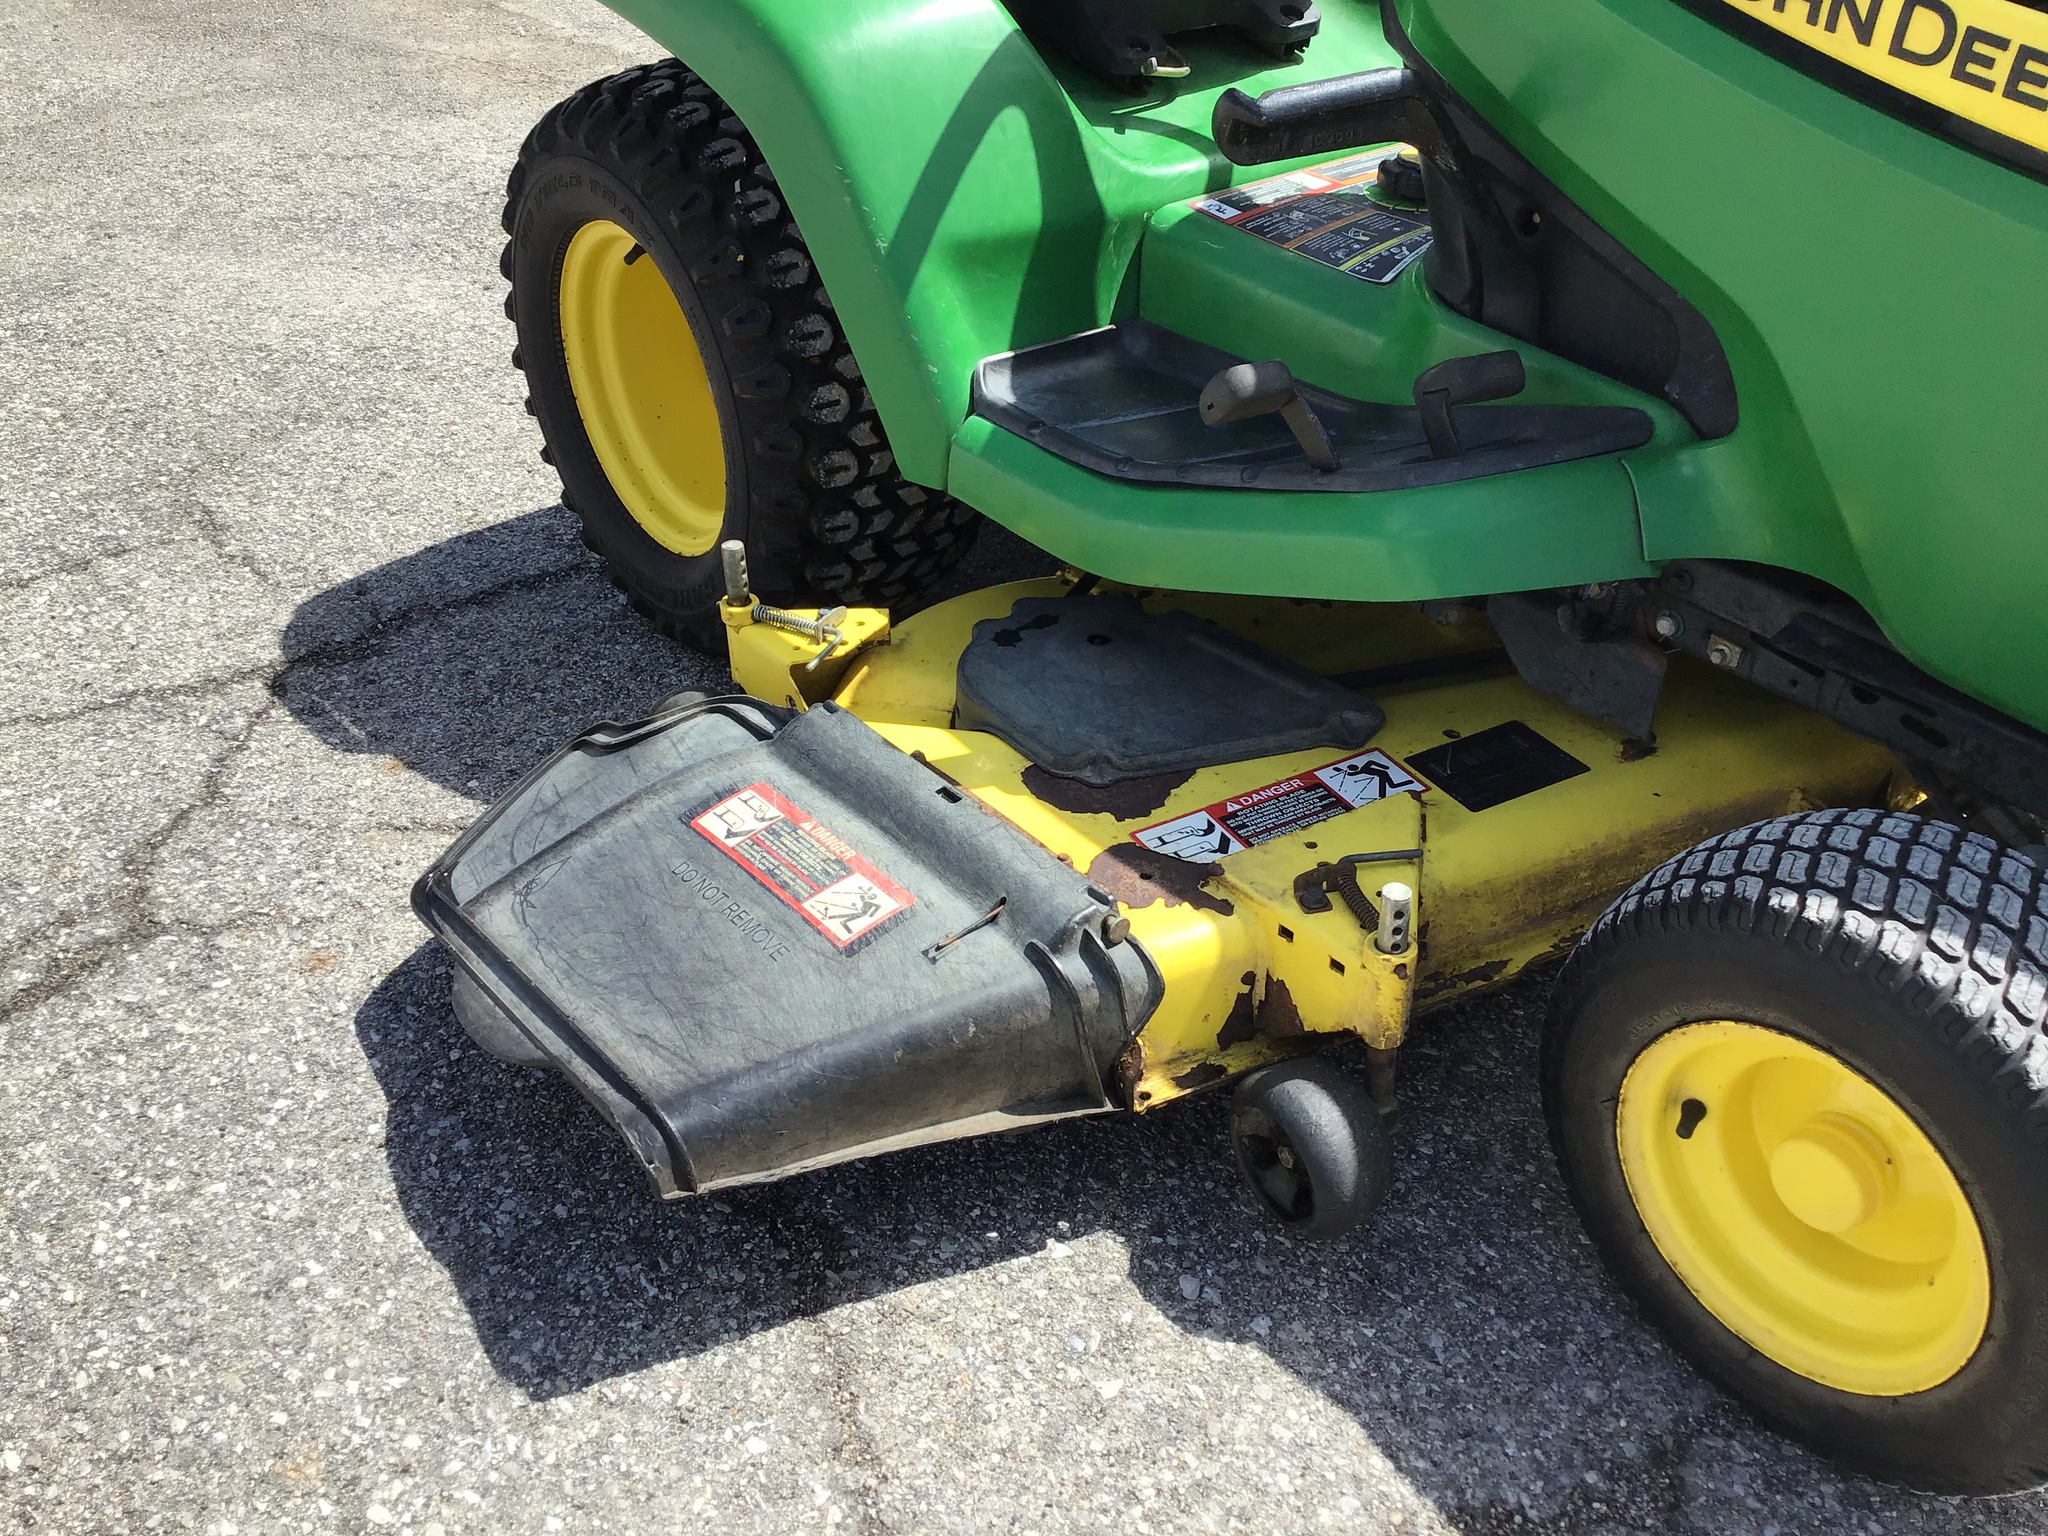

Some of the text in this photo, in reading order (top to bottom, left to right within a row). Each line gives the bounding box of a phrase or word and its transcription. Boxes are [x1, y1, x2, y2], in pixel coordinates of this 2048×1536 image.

[588, 178, 656, 248] TRAX
[1235, 789, 1307, 815] ROTATING BLADE
[1237, 777, 1305, 805] DANGER
[1256, 804, 1276, 813] HANDS
[1296, 790, 1316, 798] UNDER
[1236, 825, 1257, 834] BEFORE
[1277, 811, 1295, 819] CLEAR
[1312, 796, 1337, 807] OBJECTS
[1242, 813, 1263, 822] MOWER
[1262, 807, 1279, 815] WHEN
[1278, 801, 1298, 809] ENGINE
[1245, 798, 1320, 826] THROWN OBJECTS
[1269, 822, 1296, 834] OPERATE
[1295, 814, 1318, 824] MOWER
[1316, 806, 1343, 817] WITHOUT
[1273, 814, 1298, 825] THROWN
[775, 849, 792, 862] THROWN
[778, 836, 823, 870] THROWN OBJECTS
[787, 851, 800, 861] CLEAR
[795, 828, 838, 860] ROTATING BLADE
[797, 837, 812, 848] HANDS
[816, 851, 827, 859] FEET
[825, 859, 841, 870] UNDER
[809, 825, 857, 860] DANGER
[760, 851, 779, 865] OPERATE
[778, 865, 795, 878] MOWER
[794, 878, 814, 894] WITHOUT
[672, 861, 791, 962] DO NOT REMOVE
[1628, 1013, 1662, 1039] SAFETY
